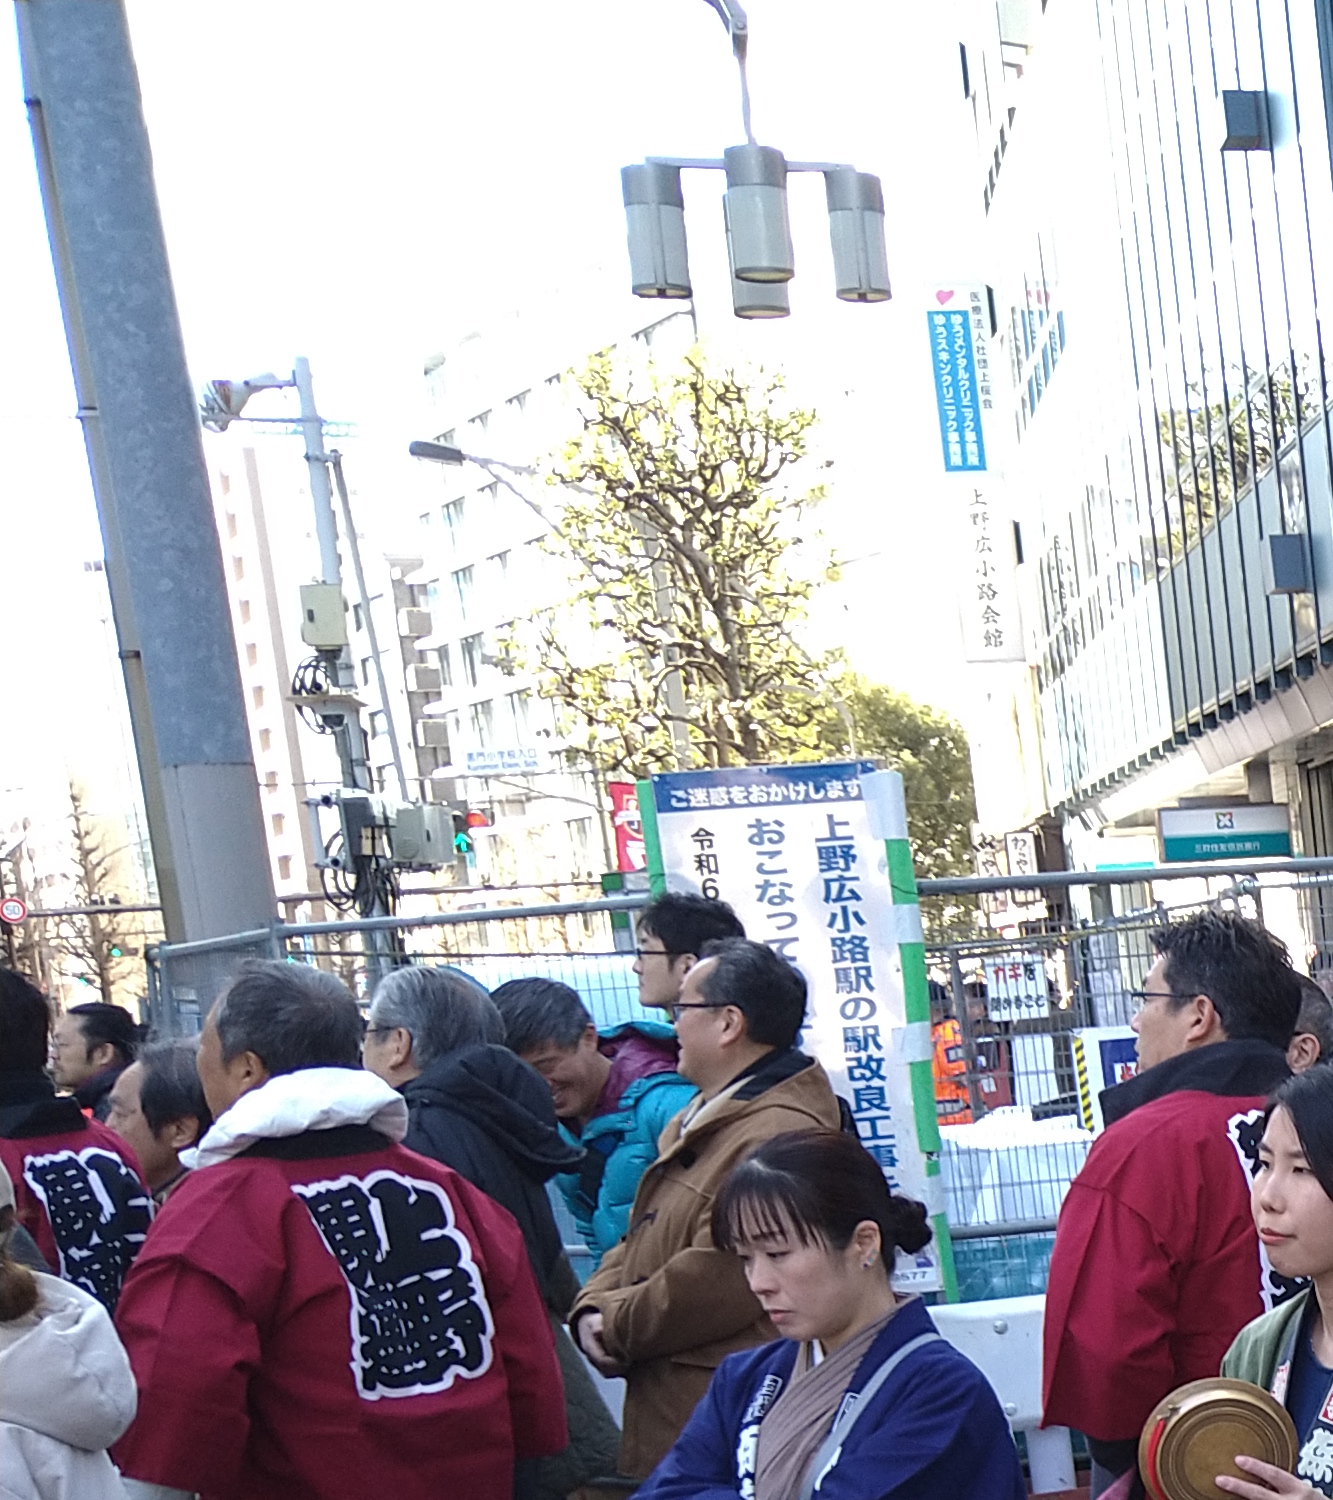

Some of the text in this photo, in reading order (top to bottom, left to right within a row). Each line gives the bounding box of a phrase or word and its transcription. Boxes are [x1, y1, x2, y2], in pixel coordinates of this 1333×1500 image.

[969, 489, 1003, 647] 上野広小路会館
[670, 778, 862, 808] ご迷惑をおかけします
[5, 905, 20, 916] 50
